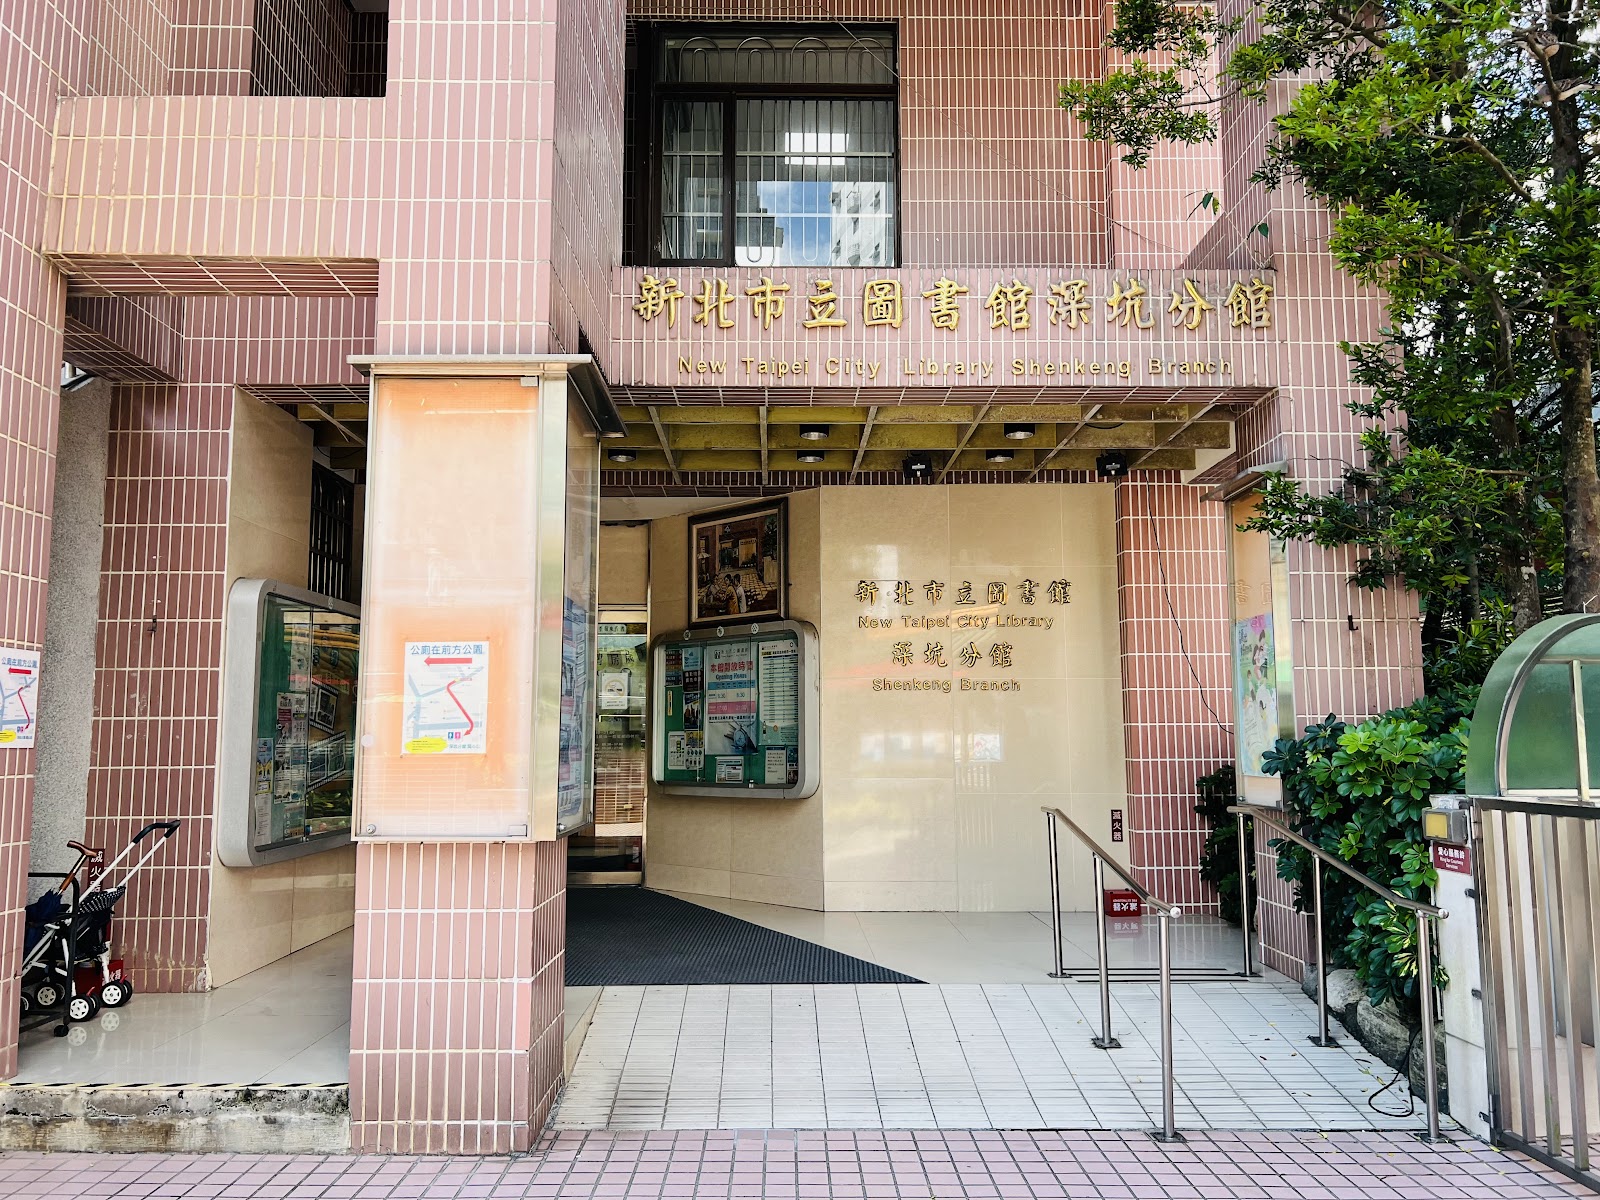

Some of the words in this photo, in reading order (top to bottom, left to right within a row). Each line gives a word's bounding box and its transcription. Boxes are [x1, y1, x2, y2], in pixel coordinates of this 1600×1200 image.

[632, 274, 1274, 332] 新北市立圖書館深坑分館
[678, 356, 727, 375] New
[741, 356, 810, 377] Taipei
[826, 356, 881, 379] City
[904, 356, 994, 379] Library
[1011, 356, 1131, 378] Shenkeng
[1148, 356, 1233, 375] Branch
[854, 579, 1072, 606] 新北市立圖書館
[858, 616, 893, 629] New
[901, 615, 950, 631] Taipei
[957, 614, 989, 630] City
[996, 614, 1054, 630] Library
[892, 641, 1014, 669] 深坑分館
[872, 678, 952, 693] Shenkeng
[960, 678, 1021, 692] Branch
